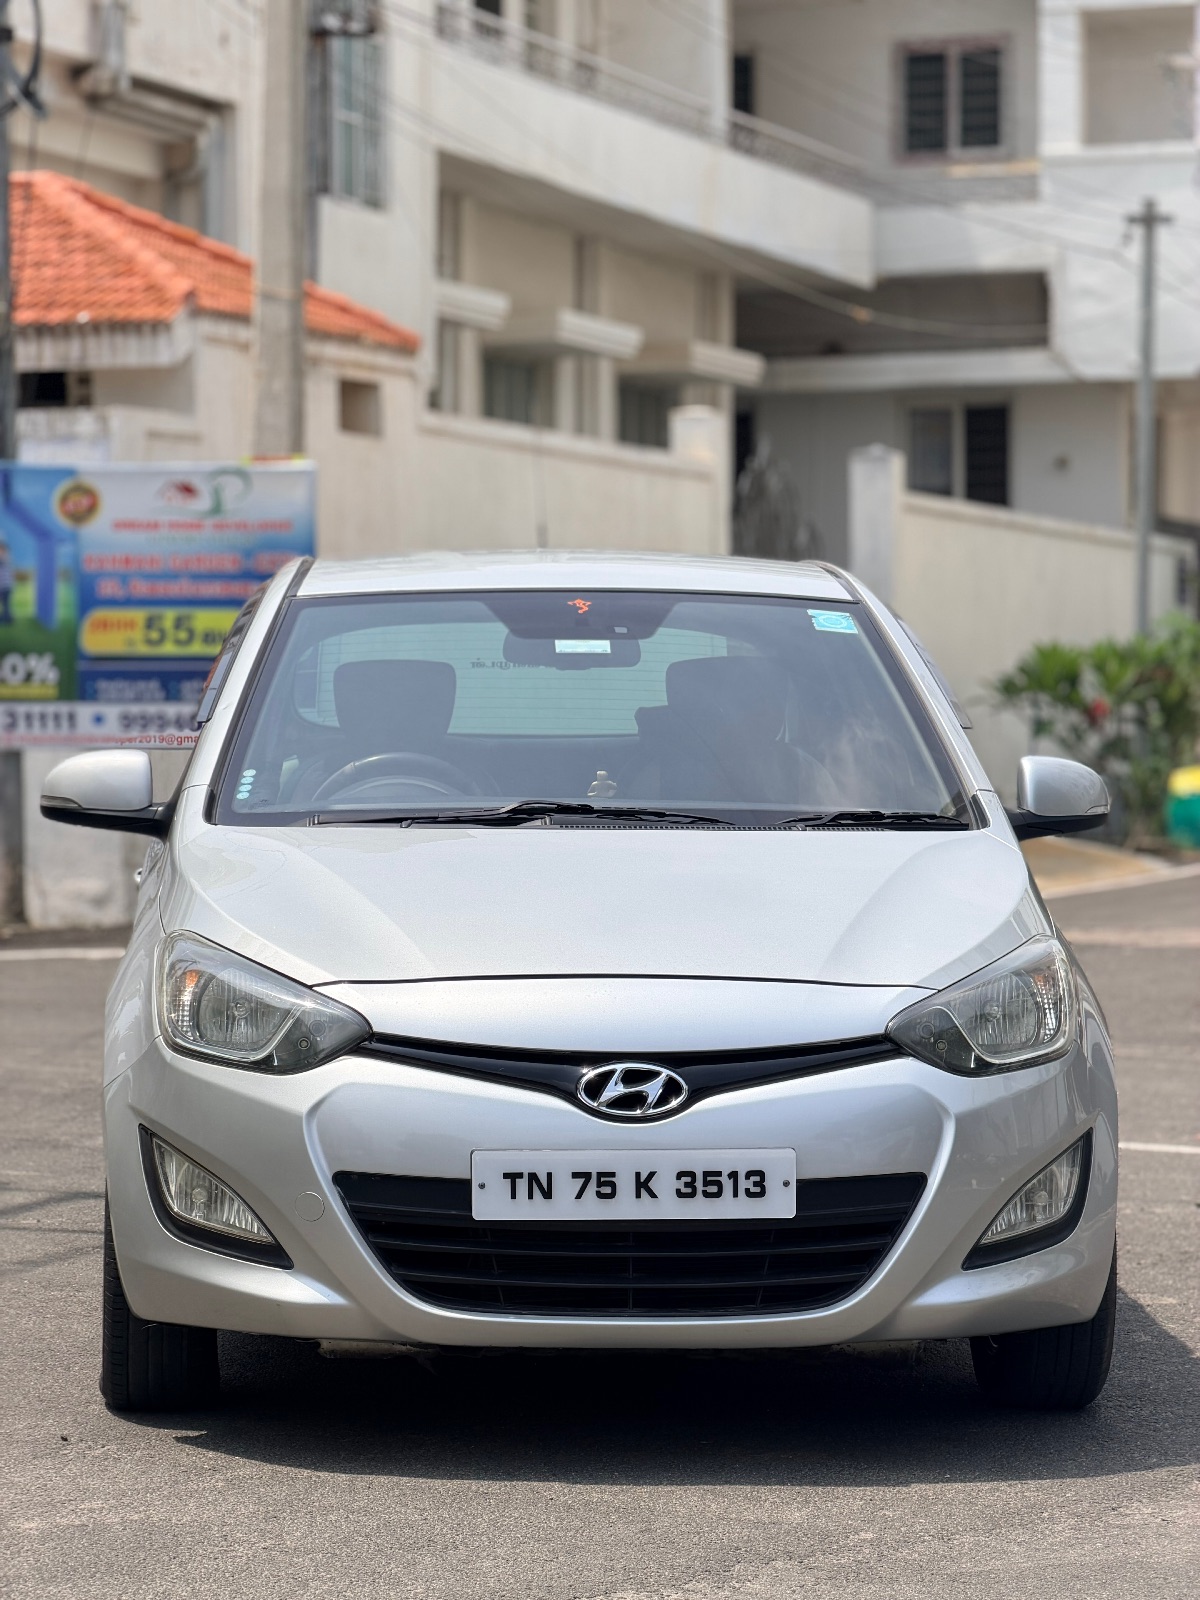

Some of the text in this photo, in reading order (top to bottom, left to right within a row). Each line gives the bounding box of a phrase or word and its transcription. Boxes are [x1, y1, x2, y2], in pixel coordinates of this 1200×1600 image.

[144, 615, 197, 646] 55
[0, 652, 60, 685] 0%
[503, 1170, 766, 1200] TN 75 K 3513
